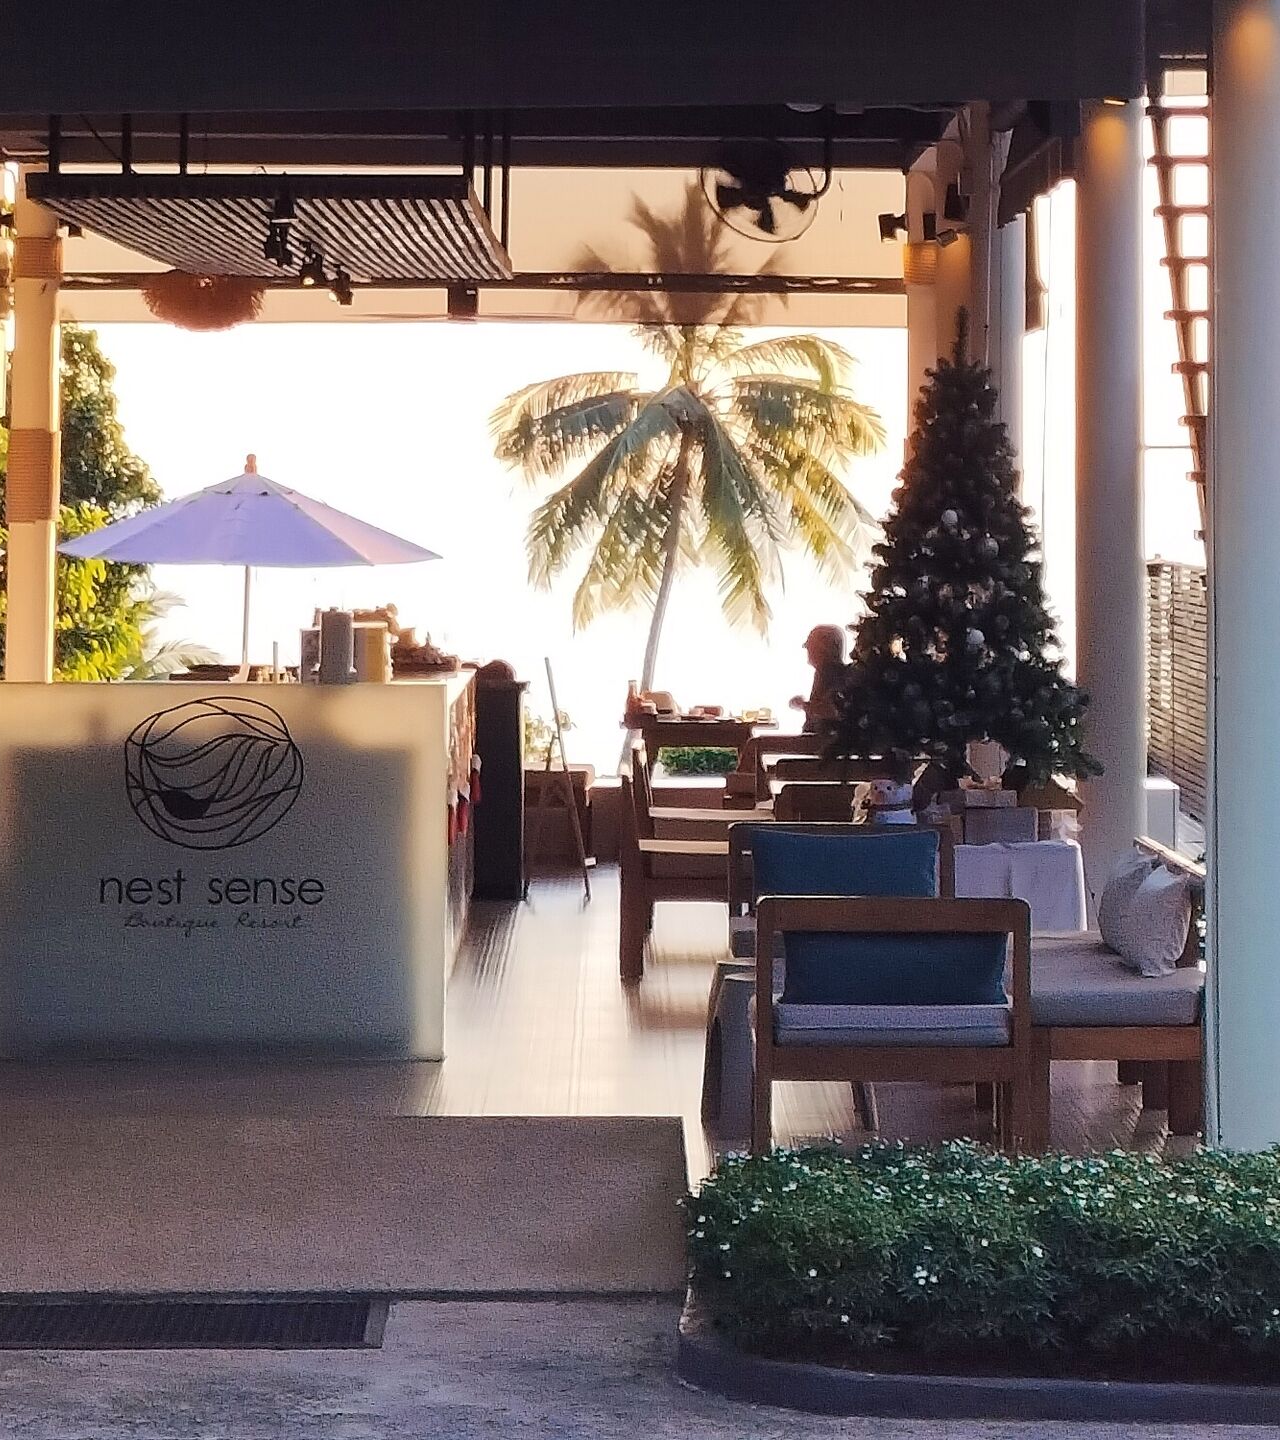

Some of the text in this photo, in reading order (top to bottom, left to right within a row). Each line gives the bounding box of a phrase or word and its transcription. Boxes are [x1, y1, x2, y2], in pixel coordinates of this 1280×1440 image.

[99, 869, 325, 905] nest sense
[124, 911, 306, 937] Boutique Resort
